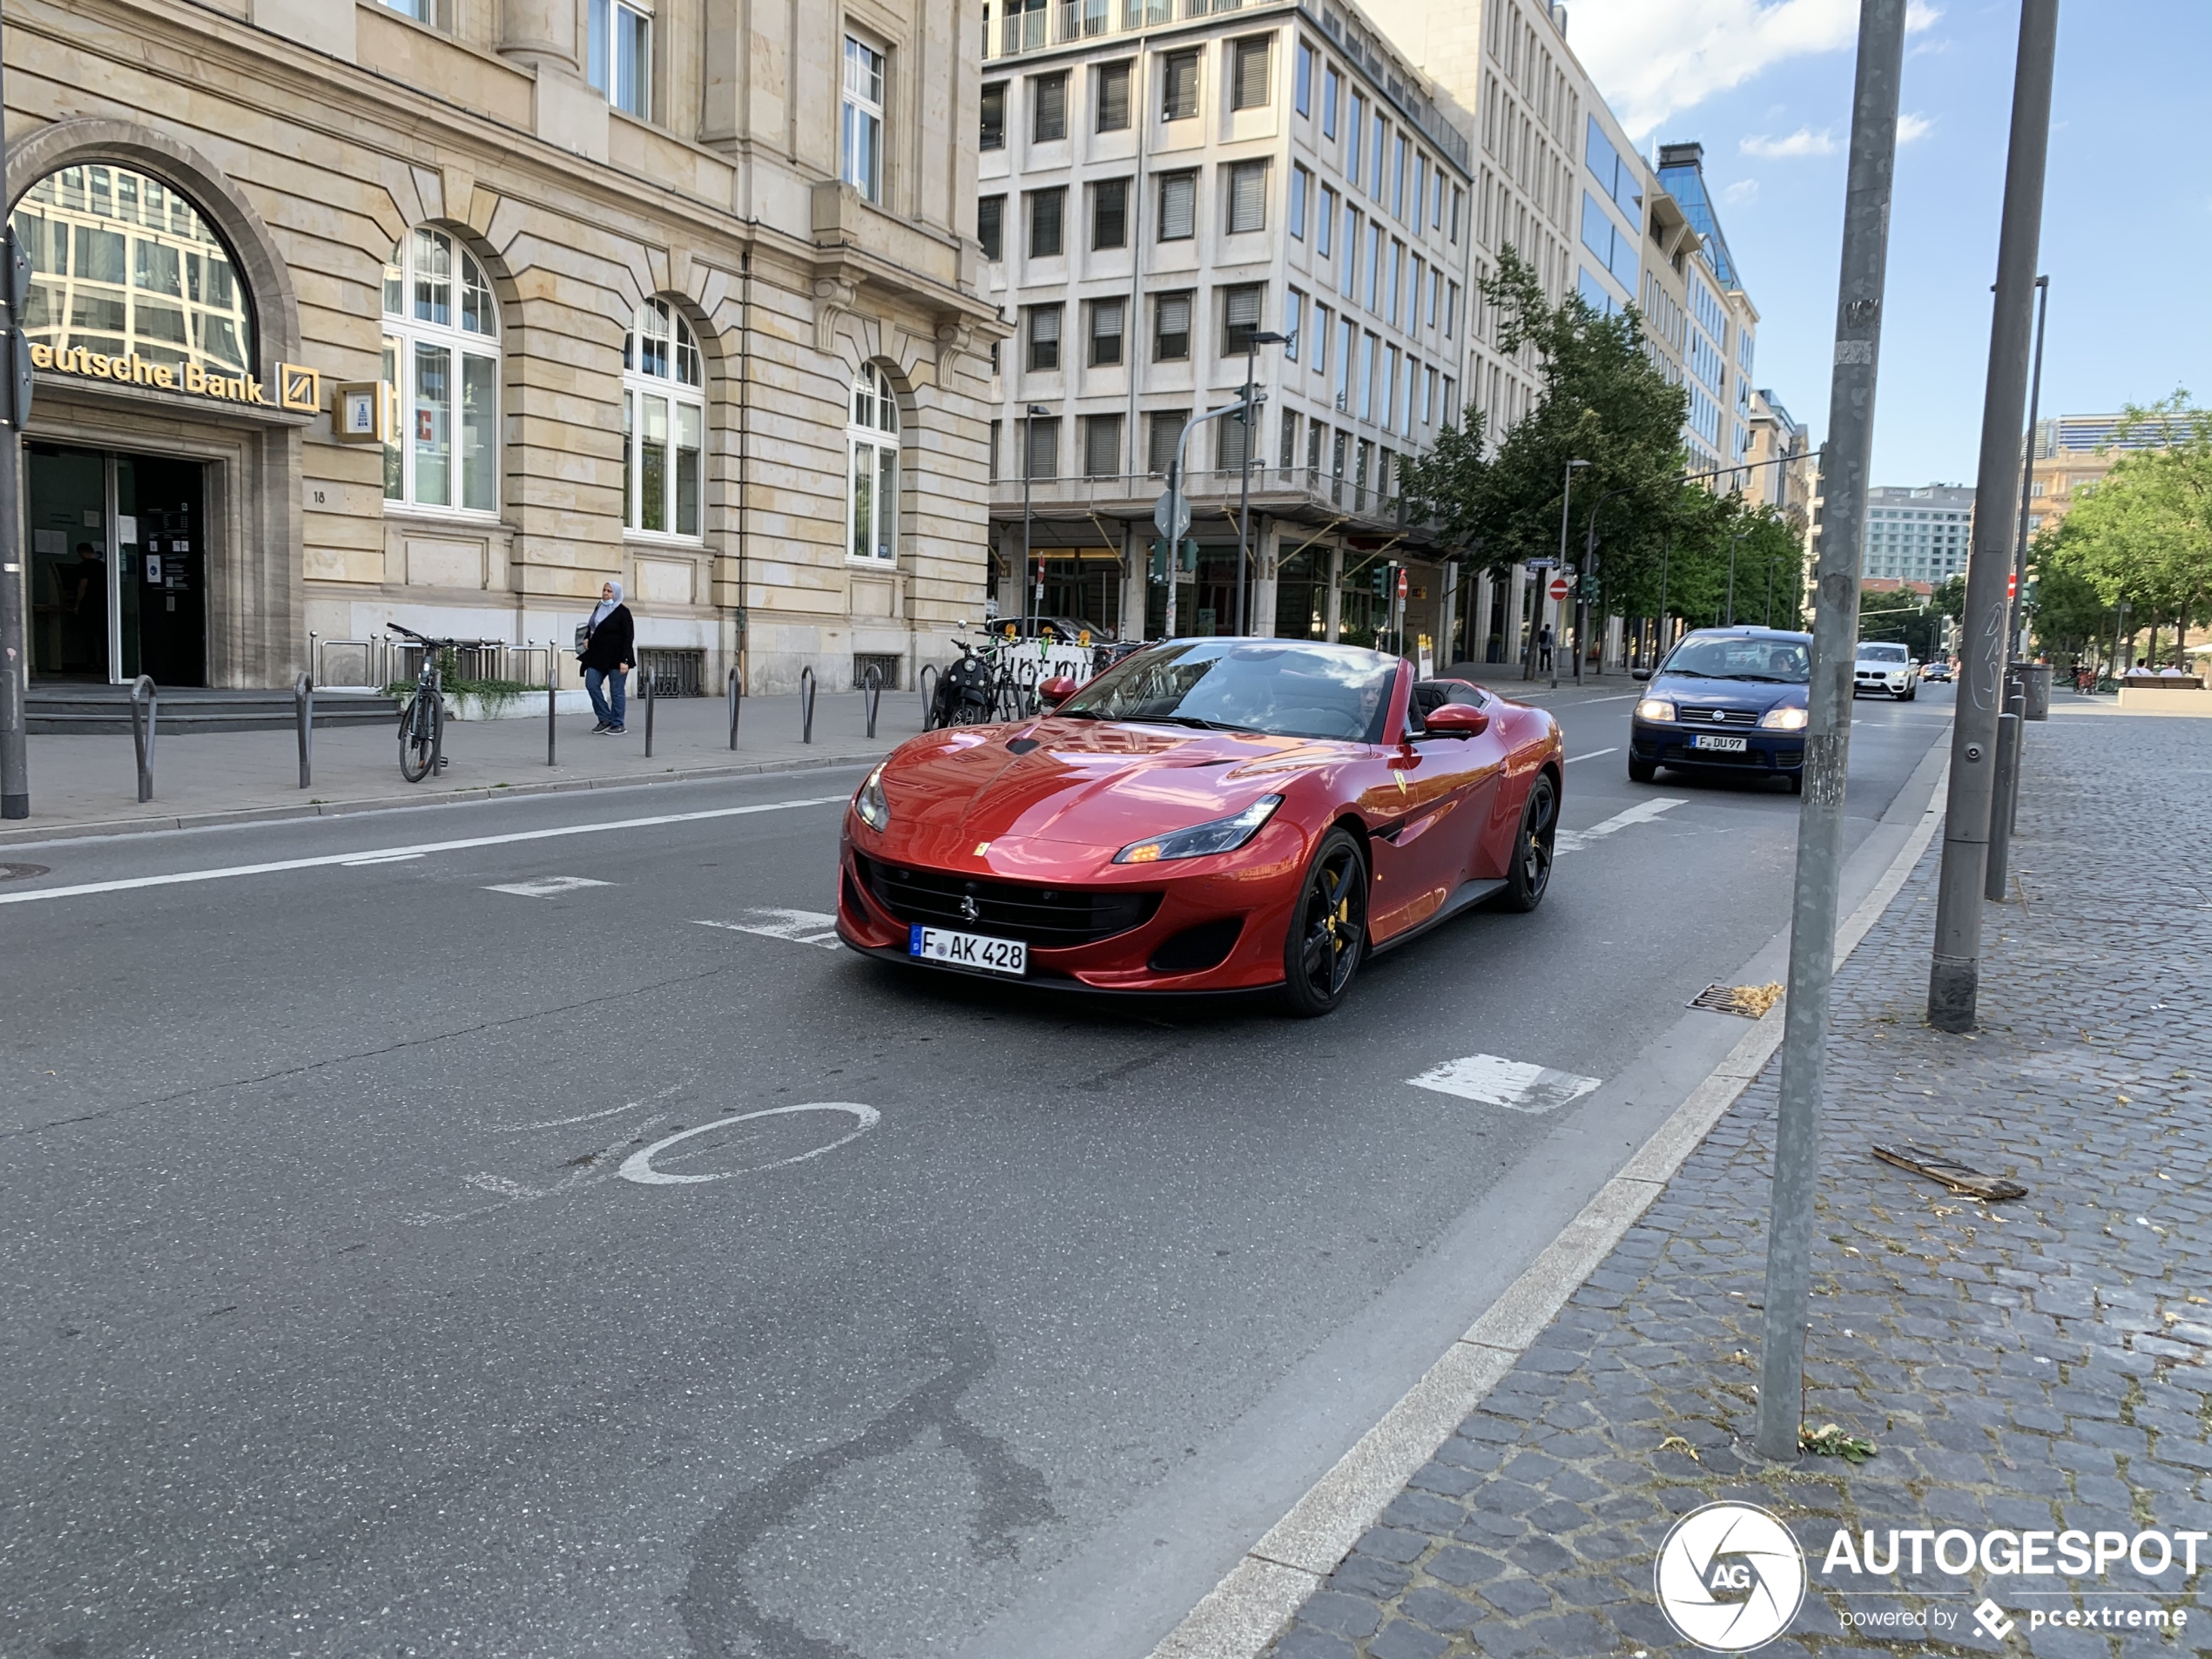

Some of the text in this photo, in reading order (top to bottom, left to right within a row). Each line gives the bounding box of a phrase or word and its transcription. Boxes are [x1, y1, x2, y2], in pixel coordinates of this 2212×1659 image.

[30, 342, 264, 404] eutsche Bank
[314, 491, 325, 503] 18
[1699, 737, 1707, 746] F
[1729, 738, 1743, 749] 97
[923, 930, 1022, 969] F AK 428
